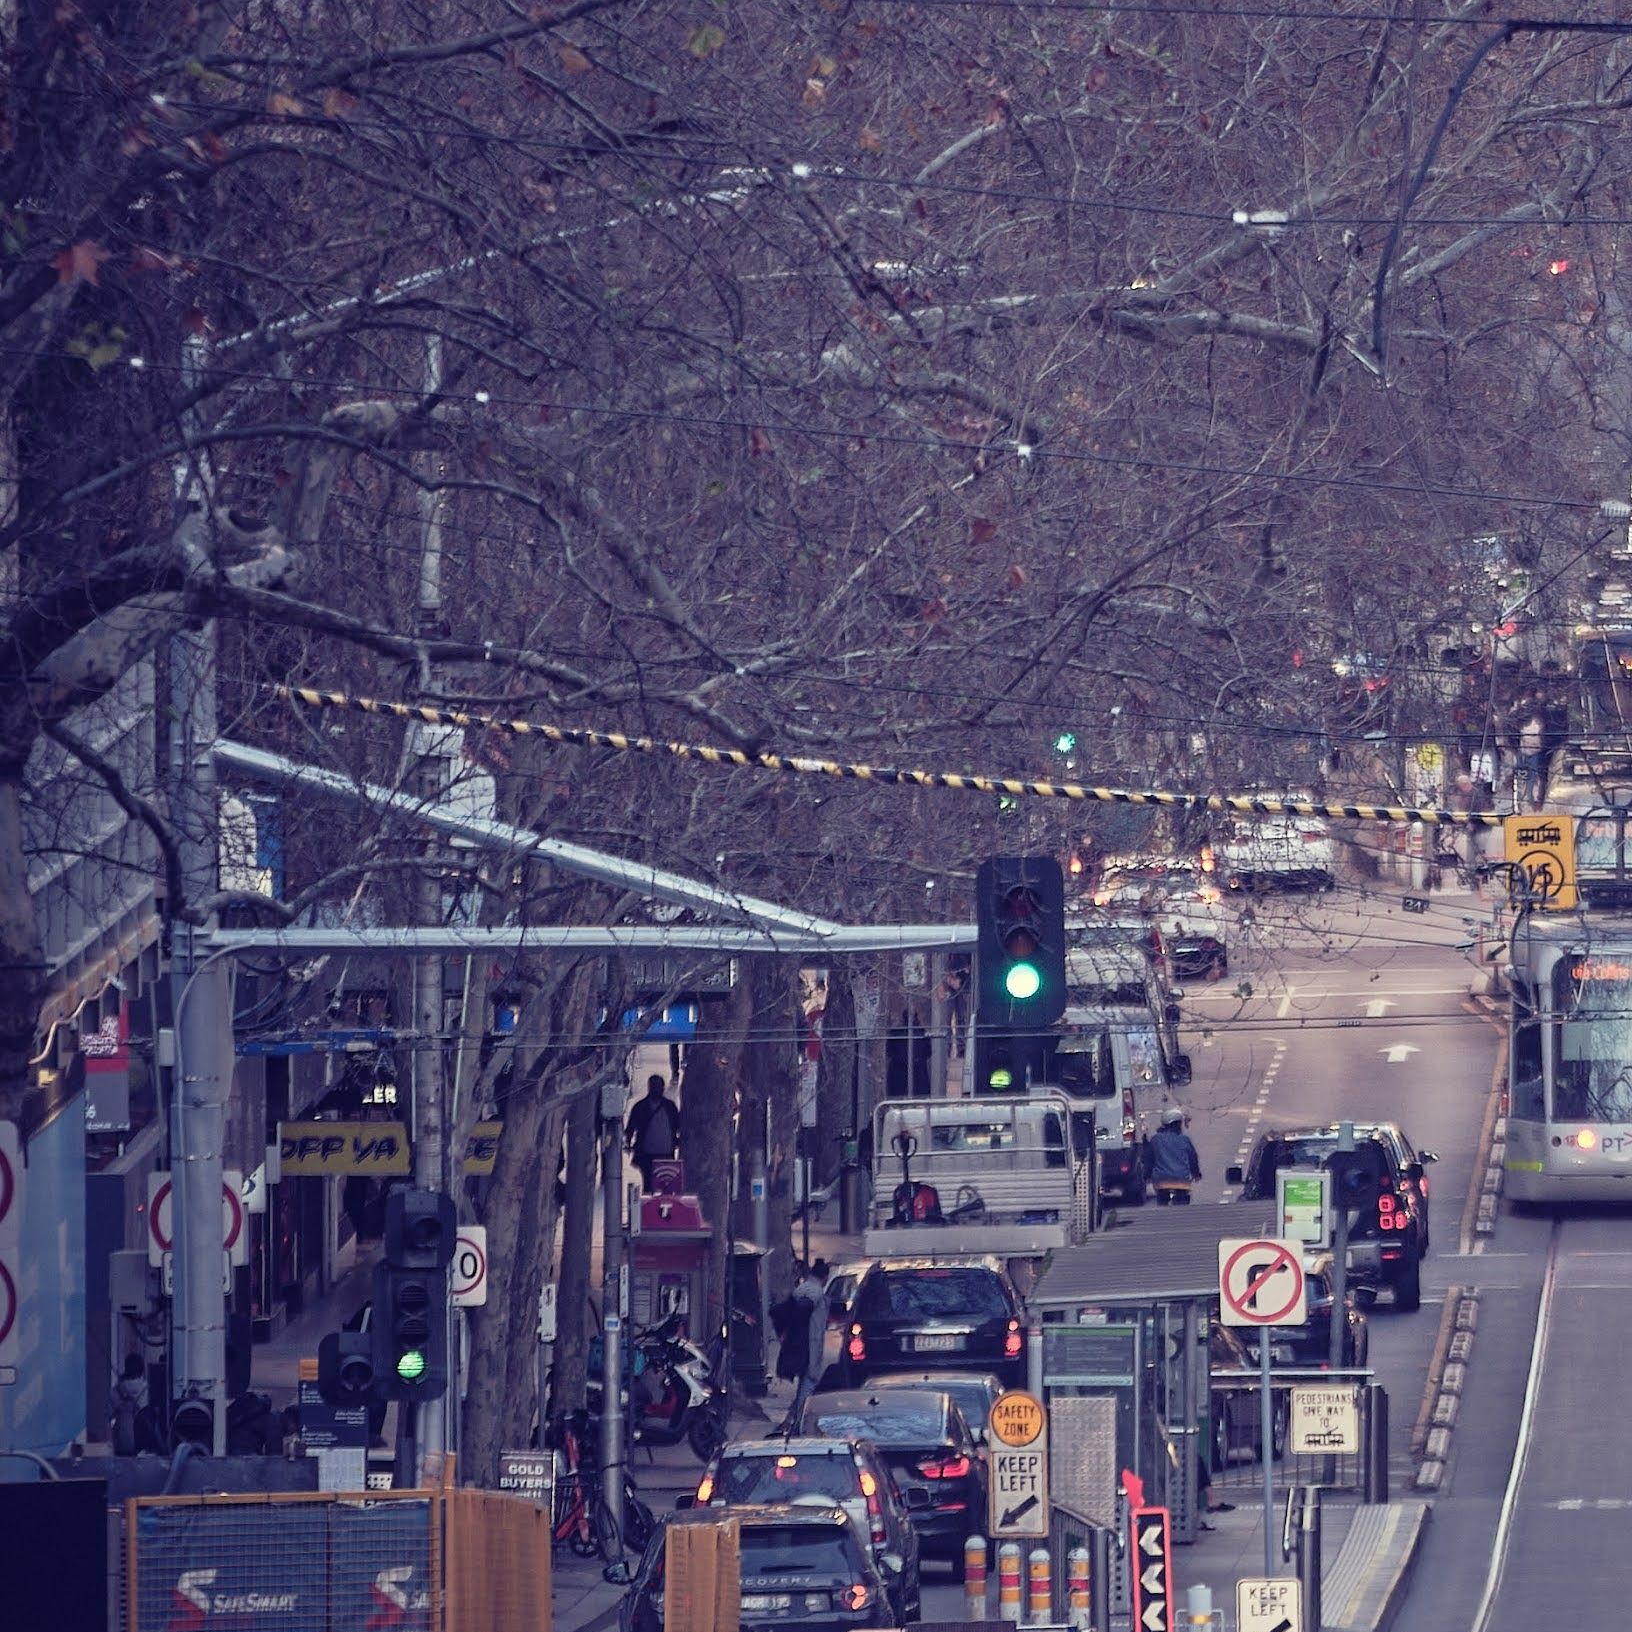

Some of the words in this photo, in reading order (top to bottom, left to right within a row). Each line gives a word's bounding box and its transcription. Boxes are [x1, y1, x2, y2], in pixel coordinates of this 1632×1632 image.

[1296, 1393, 1352, 1405] PEDESTRIANS
[998, 1405, 1036, 1419] SAFETY
[1303, 1406, 1321, 1417] GIVE
[1327, 1406, 1345, 1416] WAY
[1004, 1422, 1029, 1436] ZONE
[508, 1464, 544, 1475] GOLD
[998, 1457, 1037, 1473] KEEP
[500, 1477, 552, 1489] BUYERS
[1000, 1476, 1037, 1492] LEFT
[1250, 1587, 1288, 1601] KEEP
[1251, 1604, 1287, 1617] LEFT
